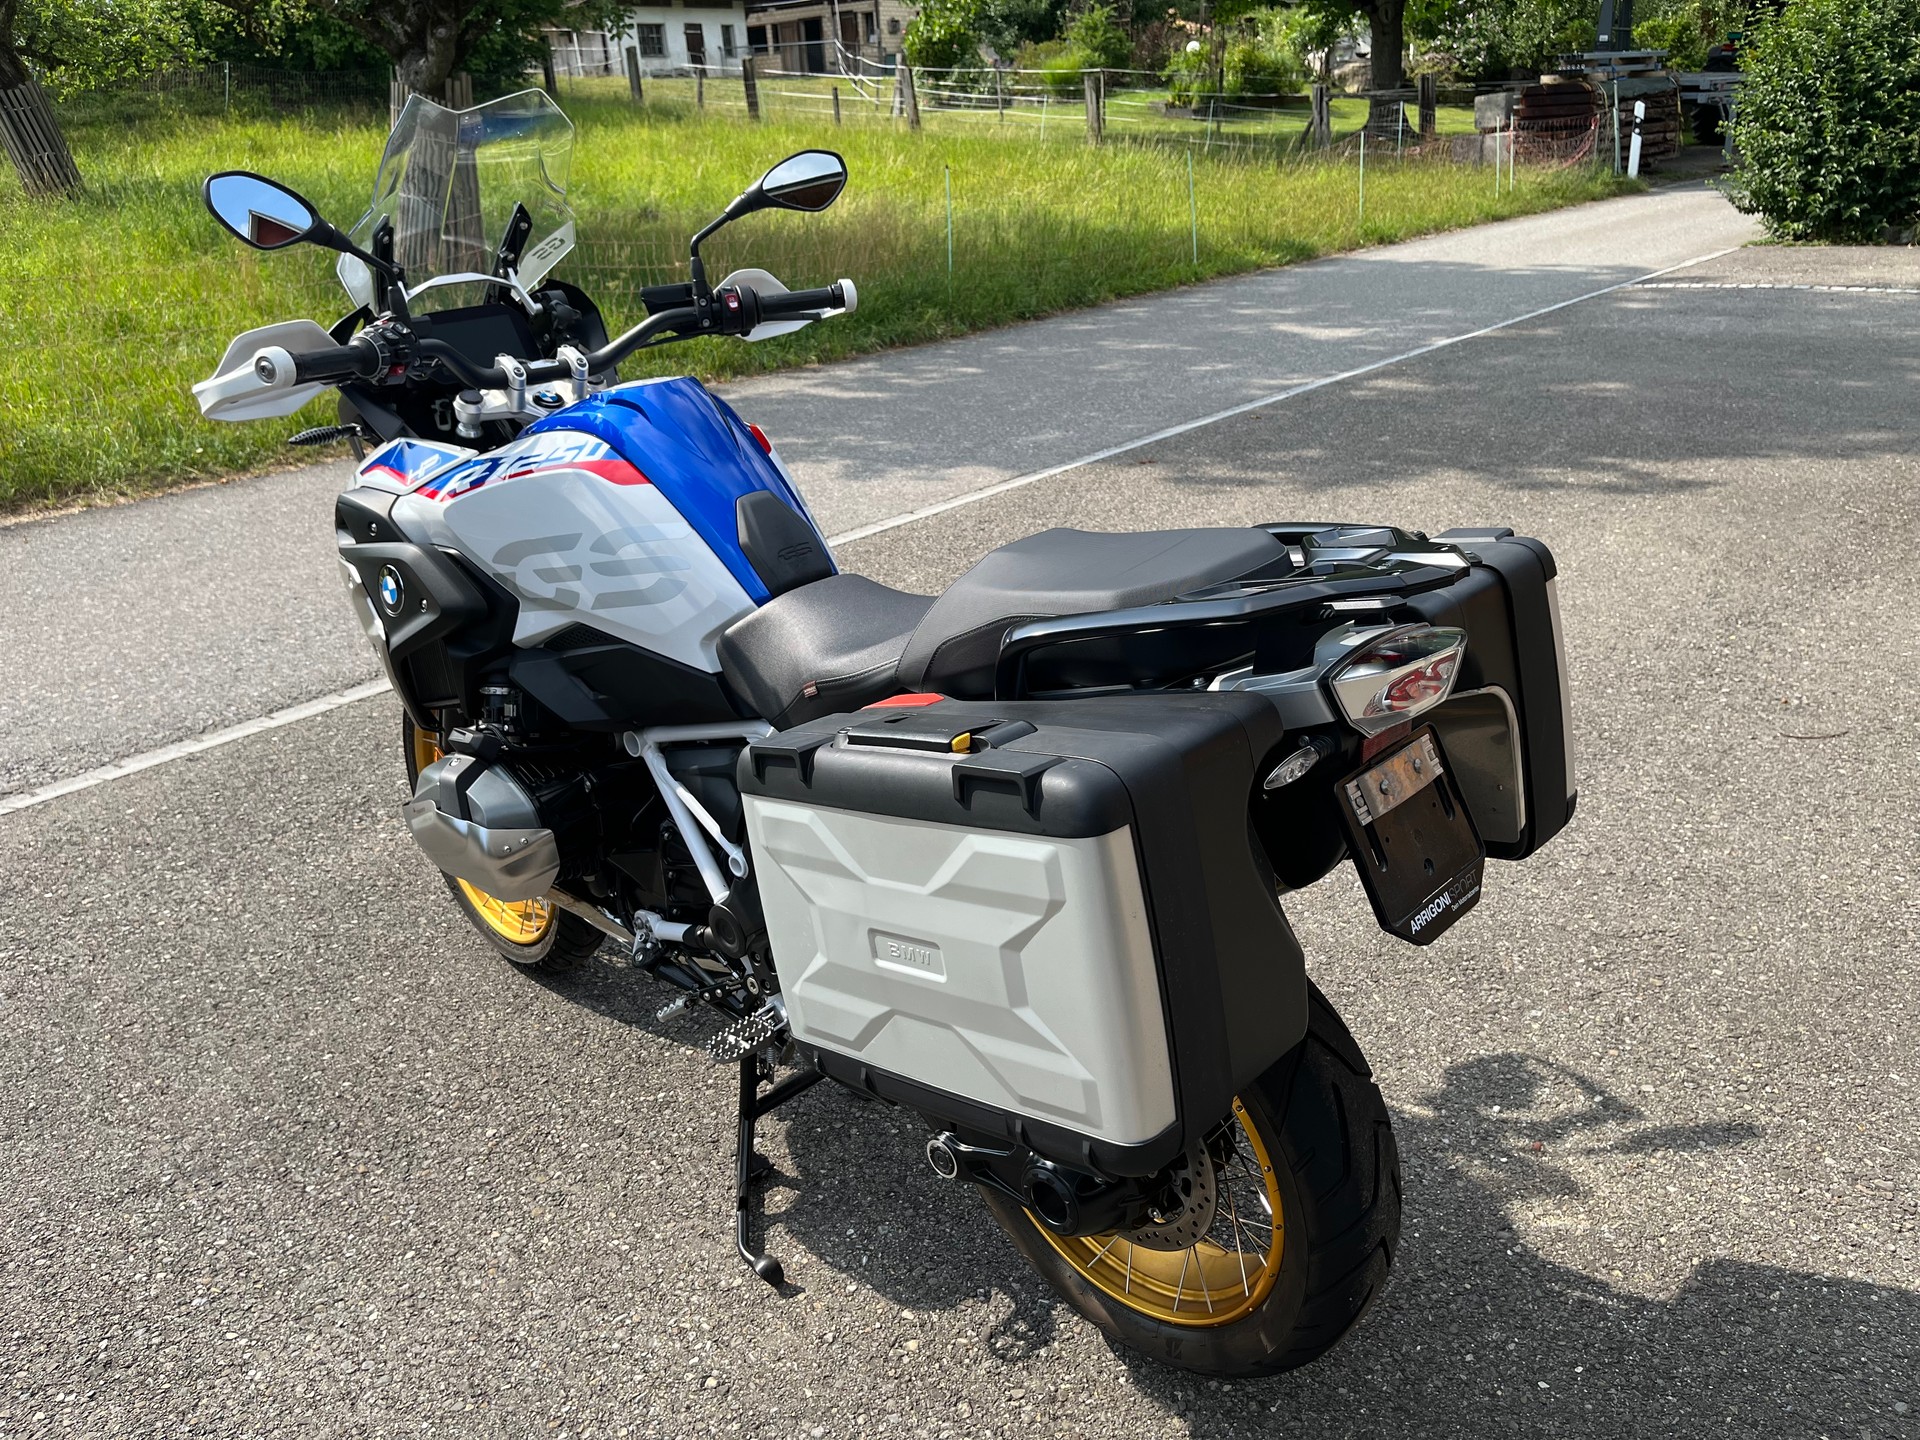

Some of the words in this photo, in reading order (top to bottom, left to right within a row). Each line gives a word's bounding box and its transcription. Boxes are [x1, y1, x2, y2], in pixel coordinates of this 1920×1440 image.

[407, 453, 441, 485] HP
[489, 439, 612, 481] 1250
[492, 522, 694, 613] GS
[887, 941, 931, 966] BMW
